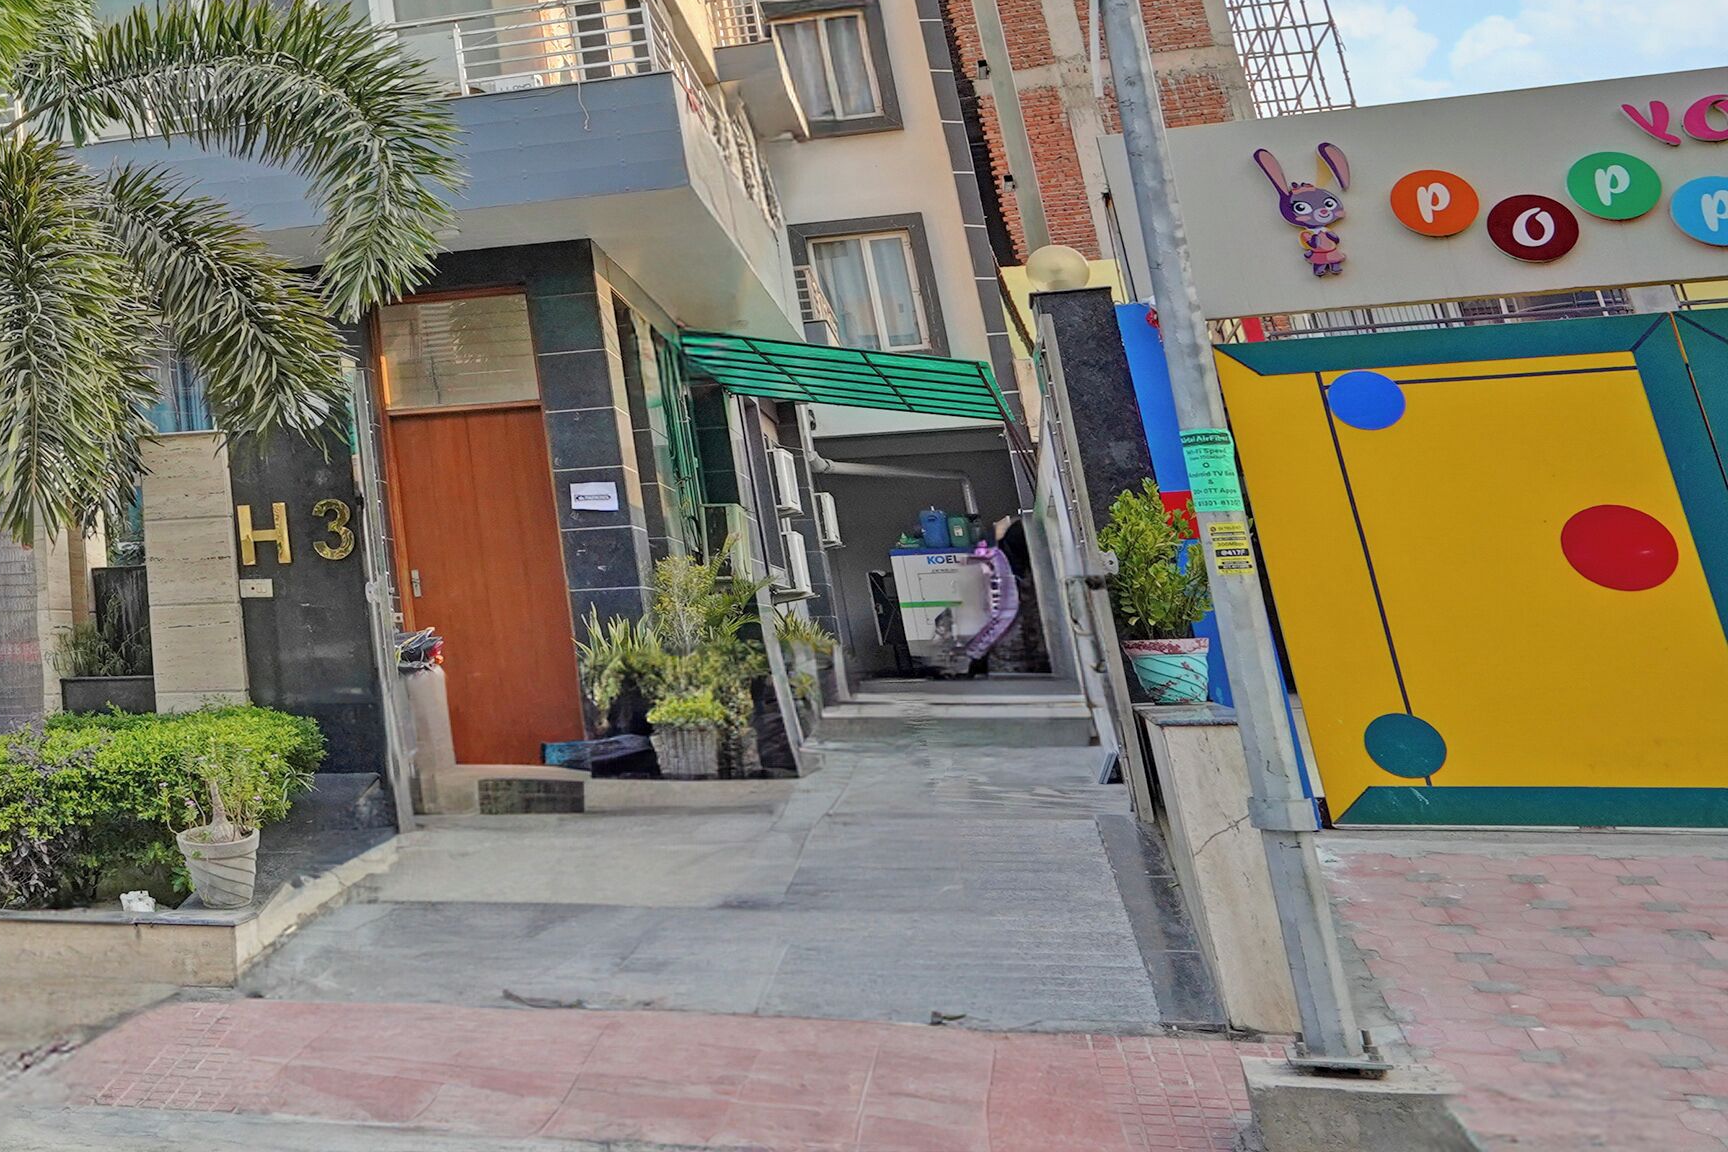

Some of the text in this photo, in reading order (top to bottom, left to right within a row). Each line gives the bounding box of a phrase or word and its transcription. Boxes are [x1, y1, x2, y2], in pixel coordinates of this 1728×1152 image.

[237, 498, 355, 565] H 3
[927, 554, 961, 565] KOEL
